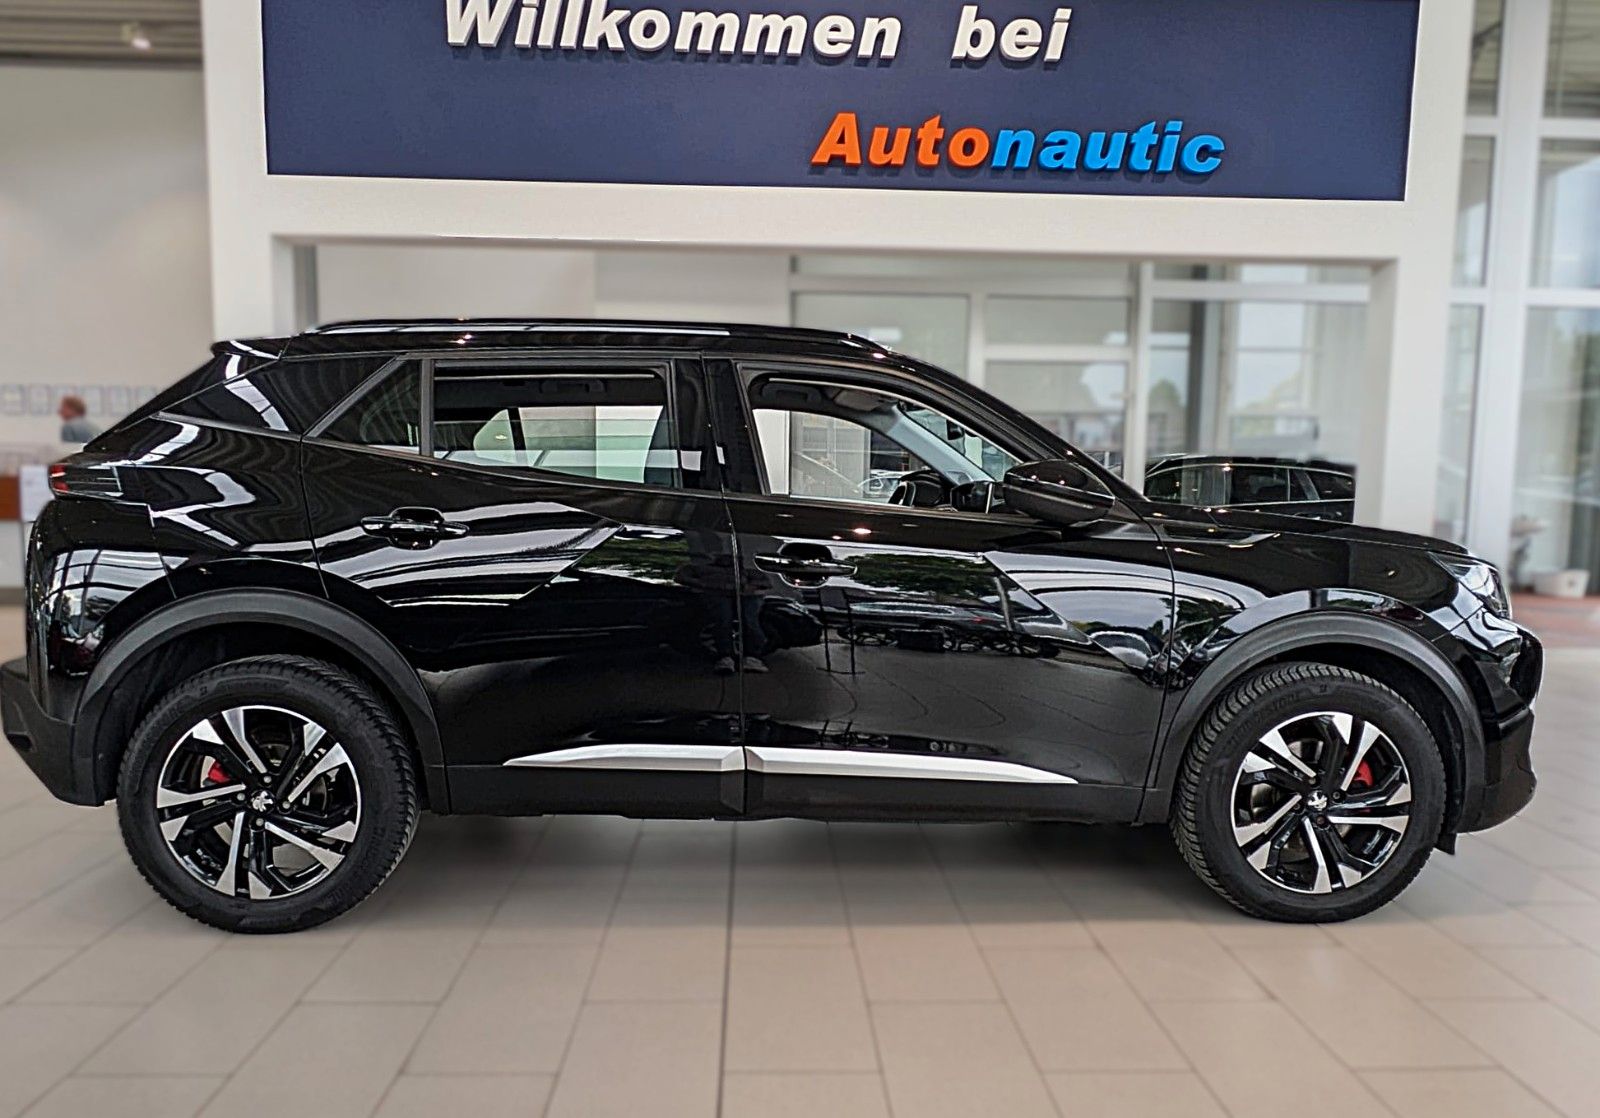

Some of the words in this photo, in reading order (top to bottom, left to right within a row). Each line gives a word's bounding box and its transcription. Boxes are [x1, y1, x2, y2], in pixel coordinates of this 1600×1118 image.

[445, 0, 902, 59] Willkommen
[951, 5, 1073, 63] bei
[811, 112, 1226, 174] Autonautic
